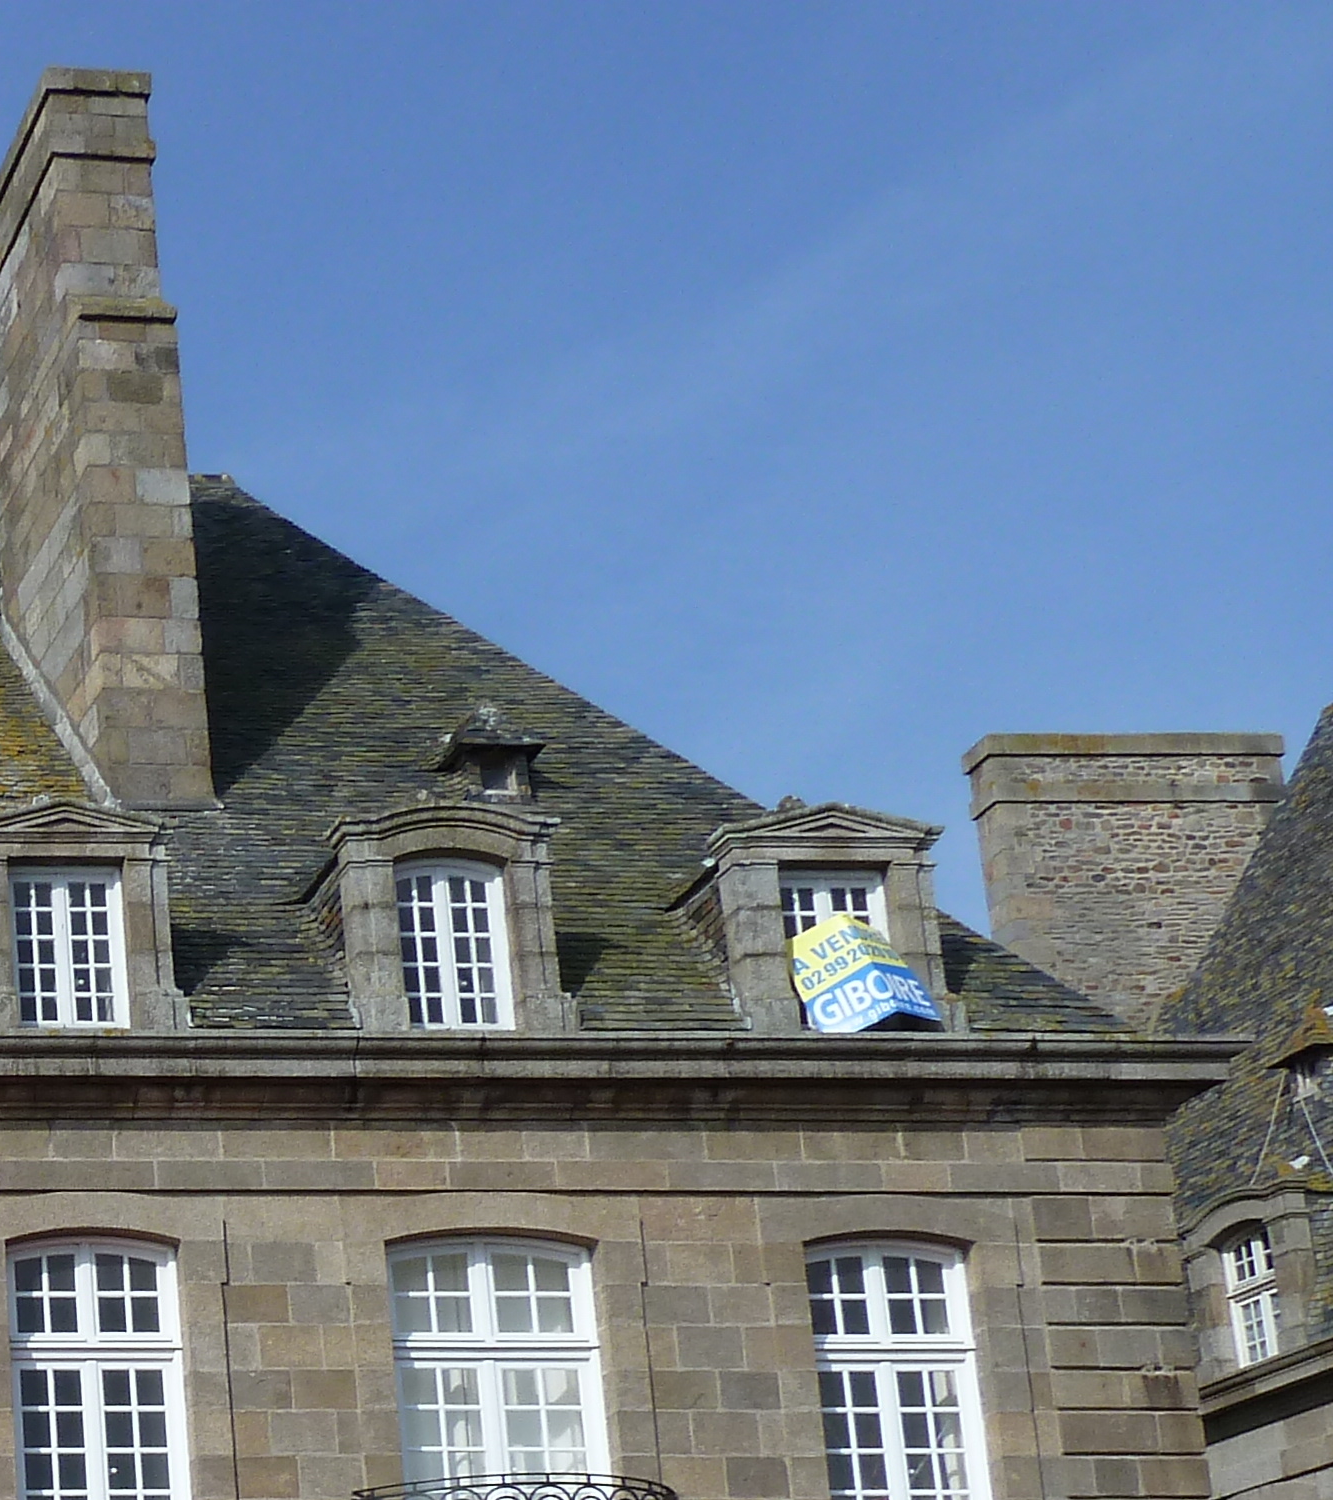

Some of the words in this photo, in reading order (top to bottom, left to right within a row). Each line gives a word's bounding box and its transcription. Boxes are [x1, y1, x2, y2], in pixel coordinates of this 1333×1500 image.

[792, 957, 810, 975] A
[801, 970, 826, 991] 02
[823, 956, 849, 976] 99
[813, 969, 931, 1025] GIBOIRE
